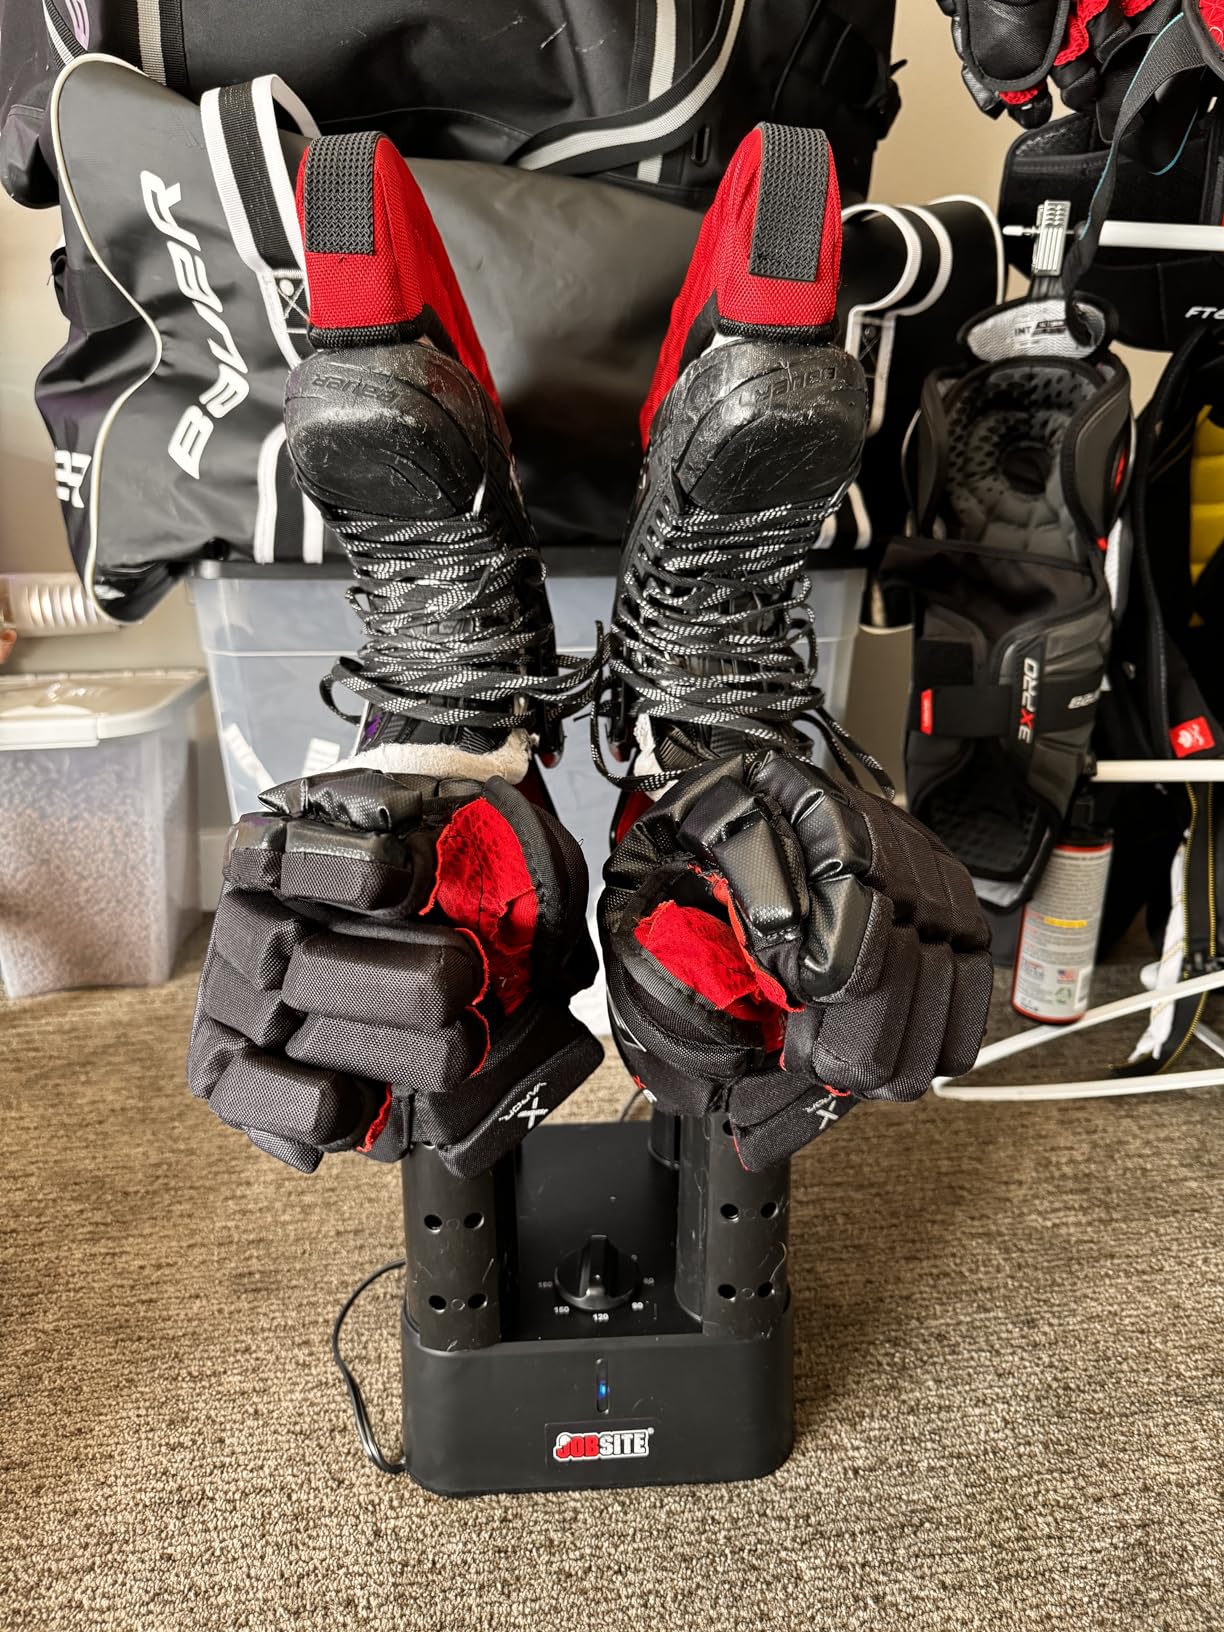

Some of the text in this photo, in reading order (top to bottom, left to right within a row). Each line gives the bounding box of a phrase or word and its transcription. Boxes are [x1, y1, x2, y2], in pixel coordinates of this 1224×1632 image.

[140, 169, 250, 480] BAUER
[592, 1312, 610, 1323] 120
[555, 1431, 647, 1459] JOBSITE
